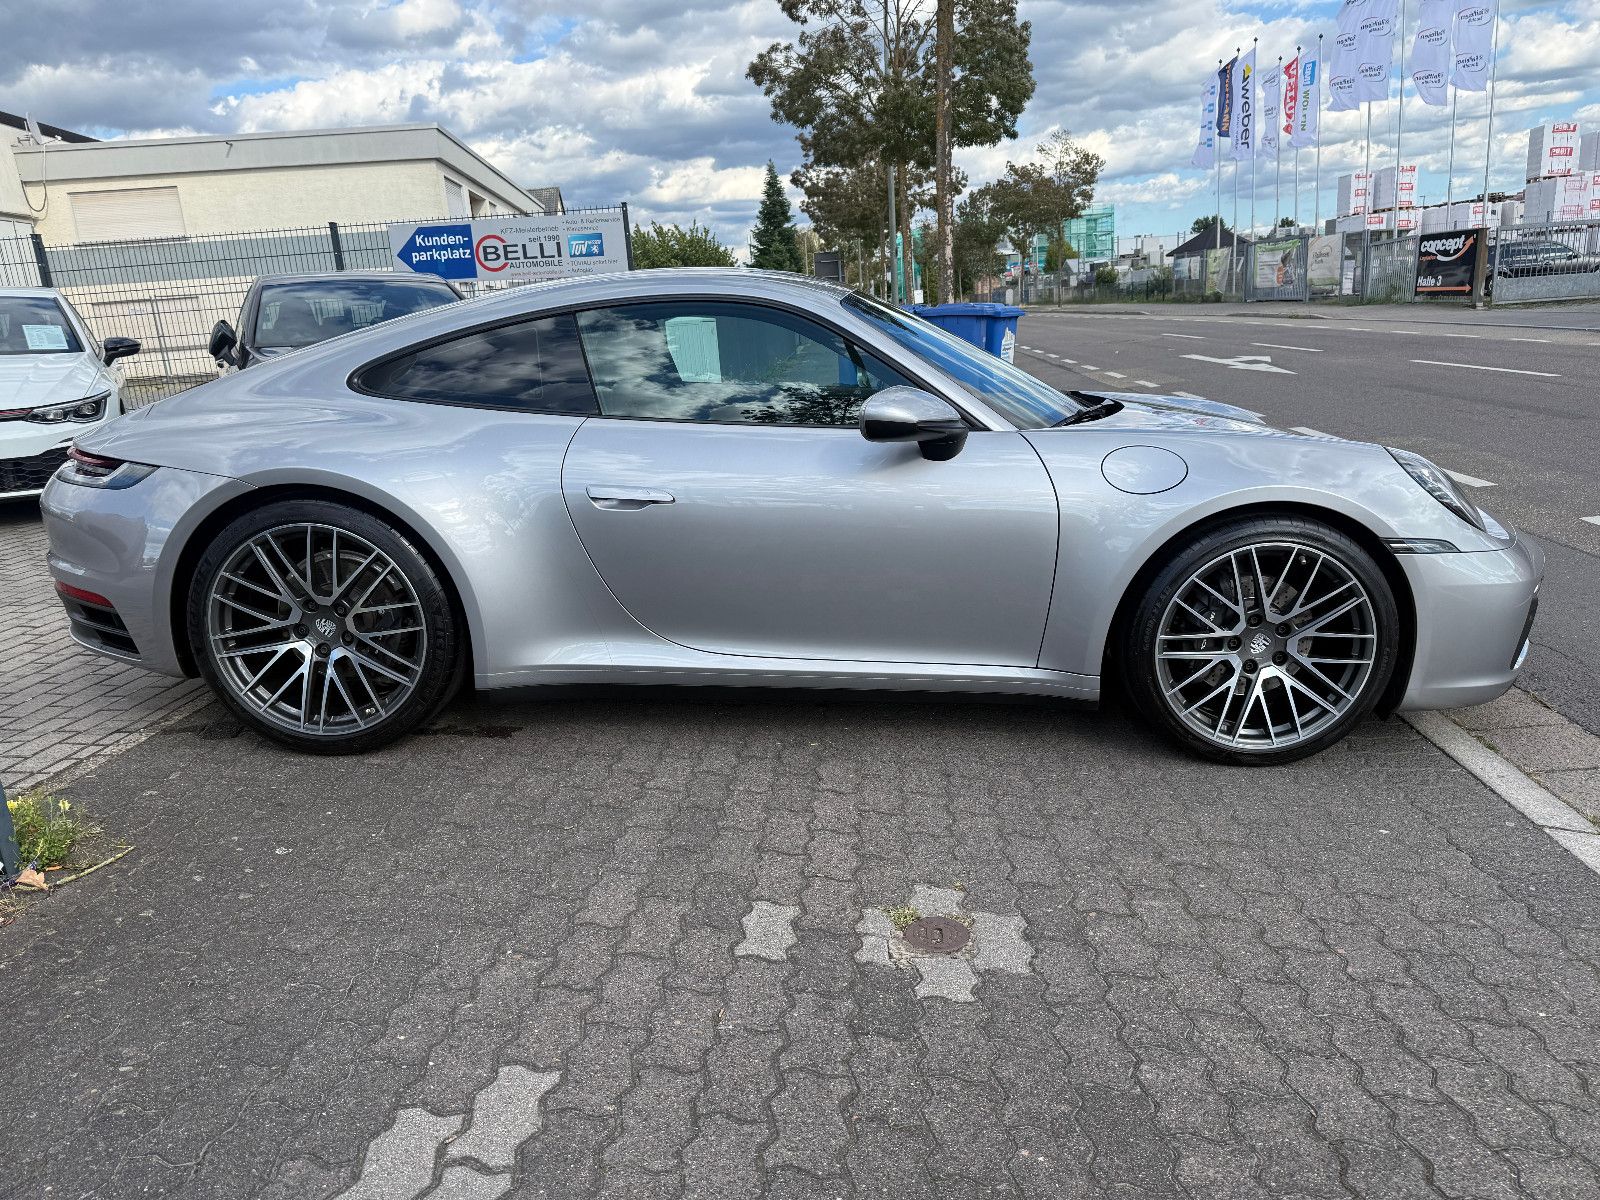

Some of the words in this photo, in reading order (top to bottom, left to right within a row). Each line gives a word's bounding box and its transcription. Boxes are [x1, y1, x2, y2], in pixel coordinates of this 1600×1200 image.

[1241, 82, 1252, 149] weber
[415, 234, 469, 246] Kunden-
[543, 234, 560, 242] 1990
[1421, 235, 1466, 253] concept
[411, 248, 472, 264] parkplatz
[509, 260, 563, 269] AUTOMOBILE
[1417, 276, 1435, 286] Halle
[1436, 275, 1442, 286] 3
